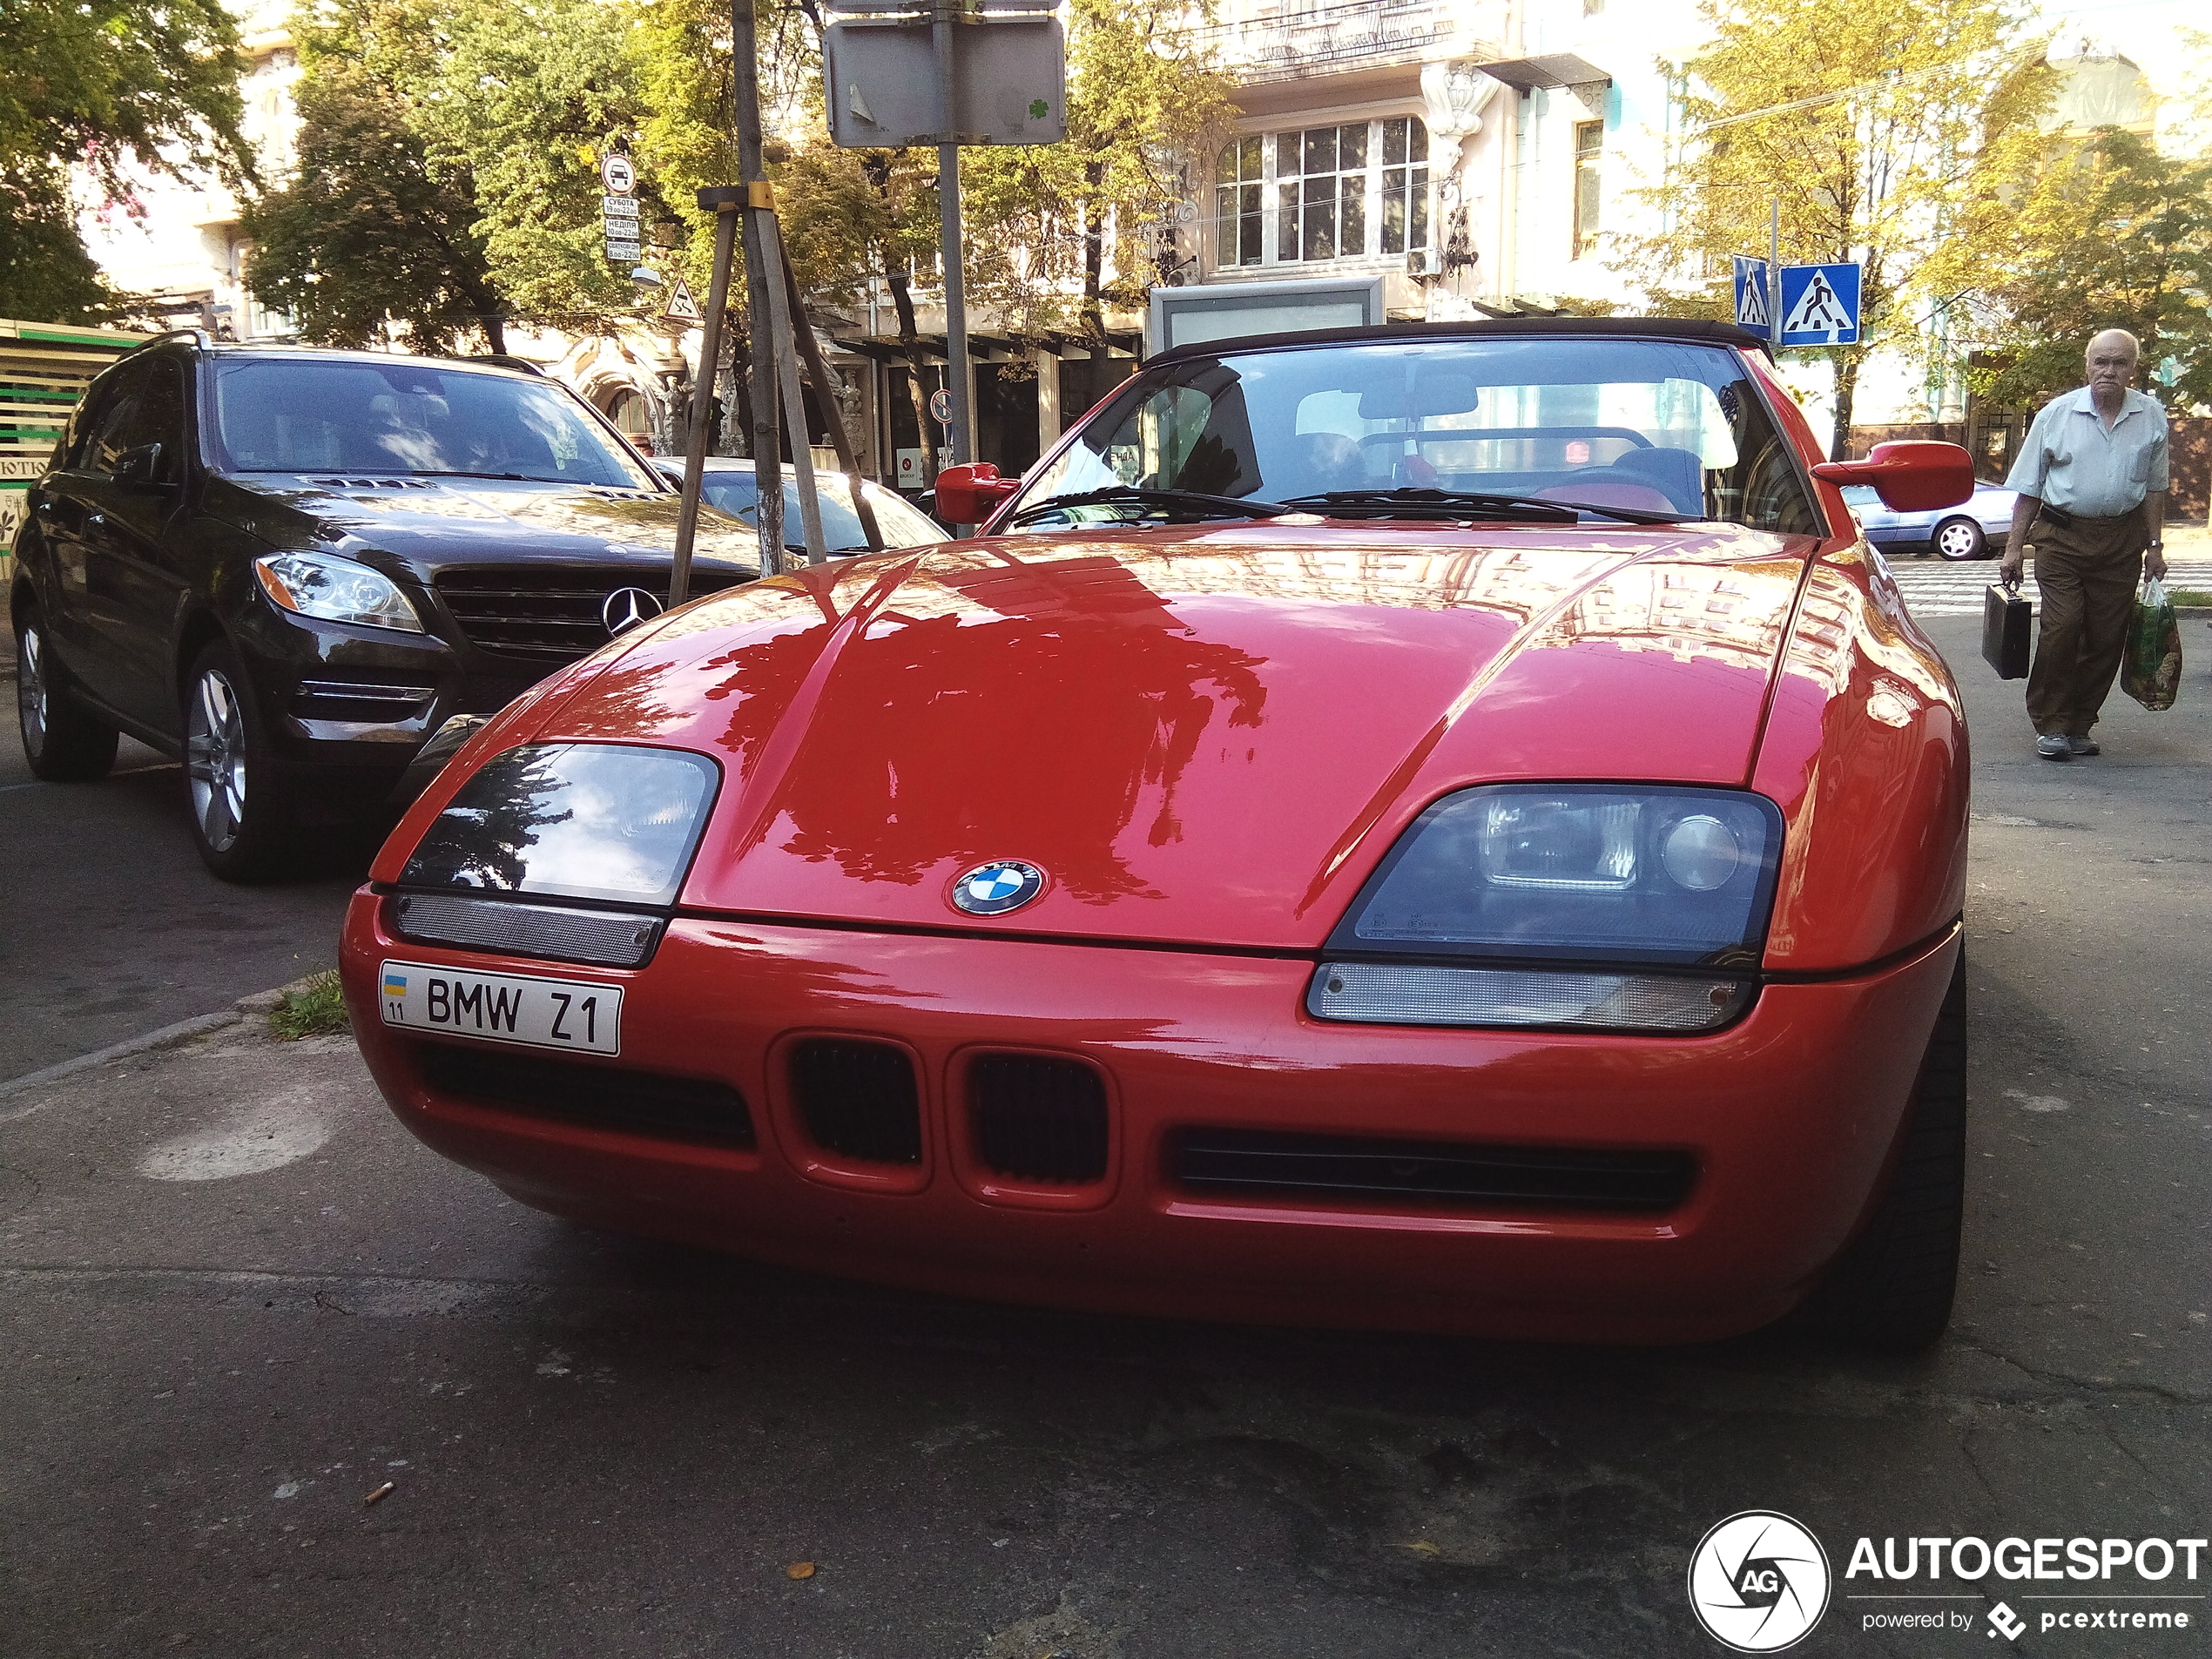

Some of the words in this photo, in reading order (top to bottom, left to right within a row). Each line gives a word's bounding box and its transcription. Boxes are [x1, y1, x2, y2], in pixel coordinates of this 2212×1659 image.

[609, 220, 637, 229] НЕДІЛЯ
[0, 462, 47, 475] ЮТЮ
[388, 1001, 404, 1021] 11
[428, 978, 523, 1033] BMW
[550, 993, 597, 1043] Z1
